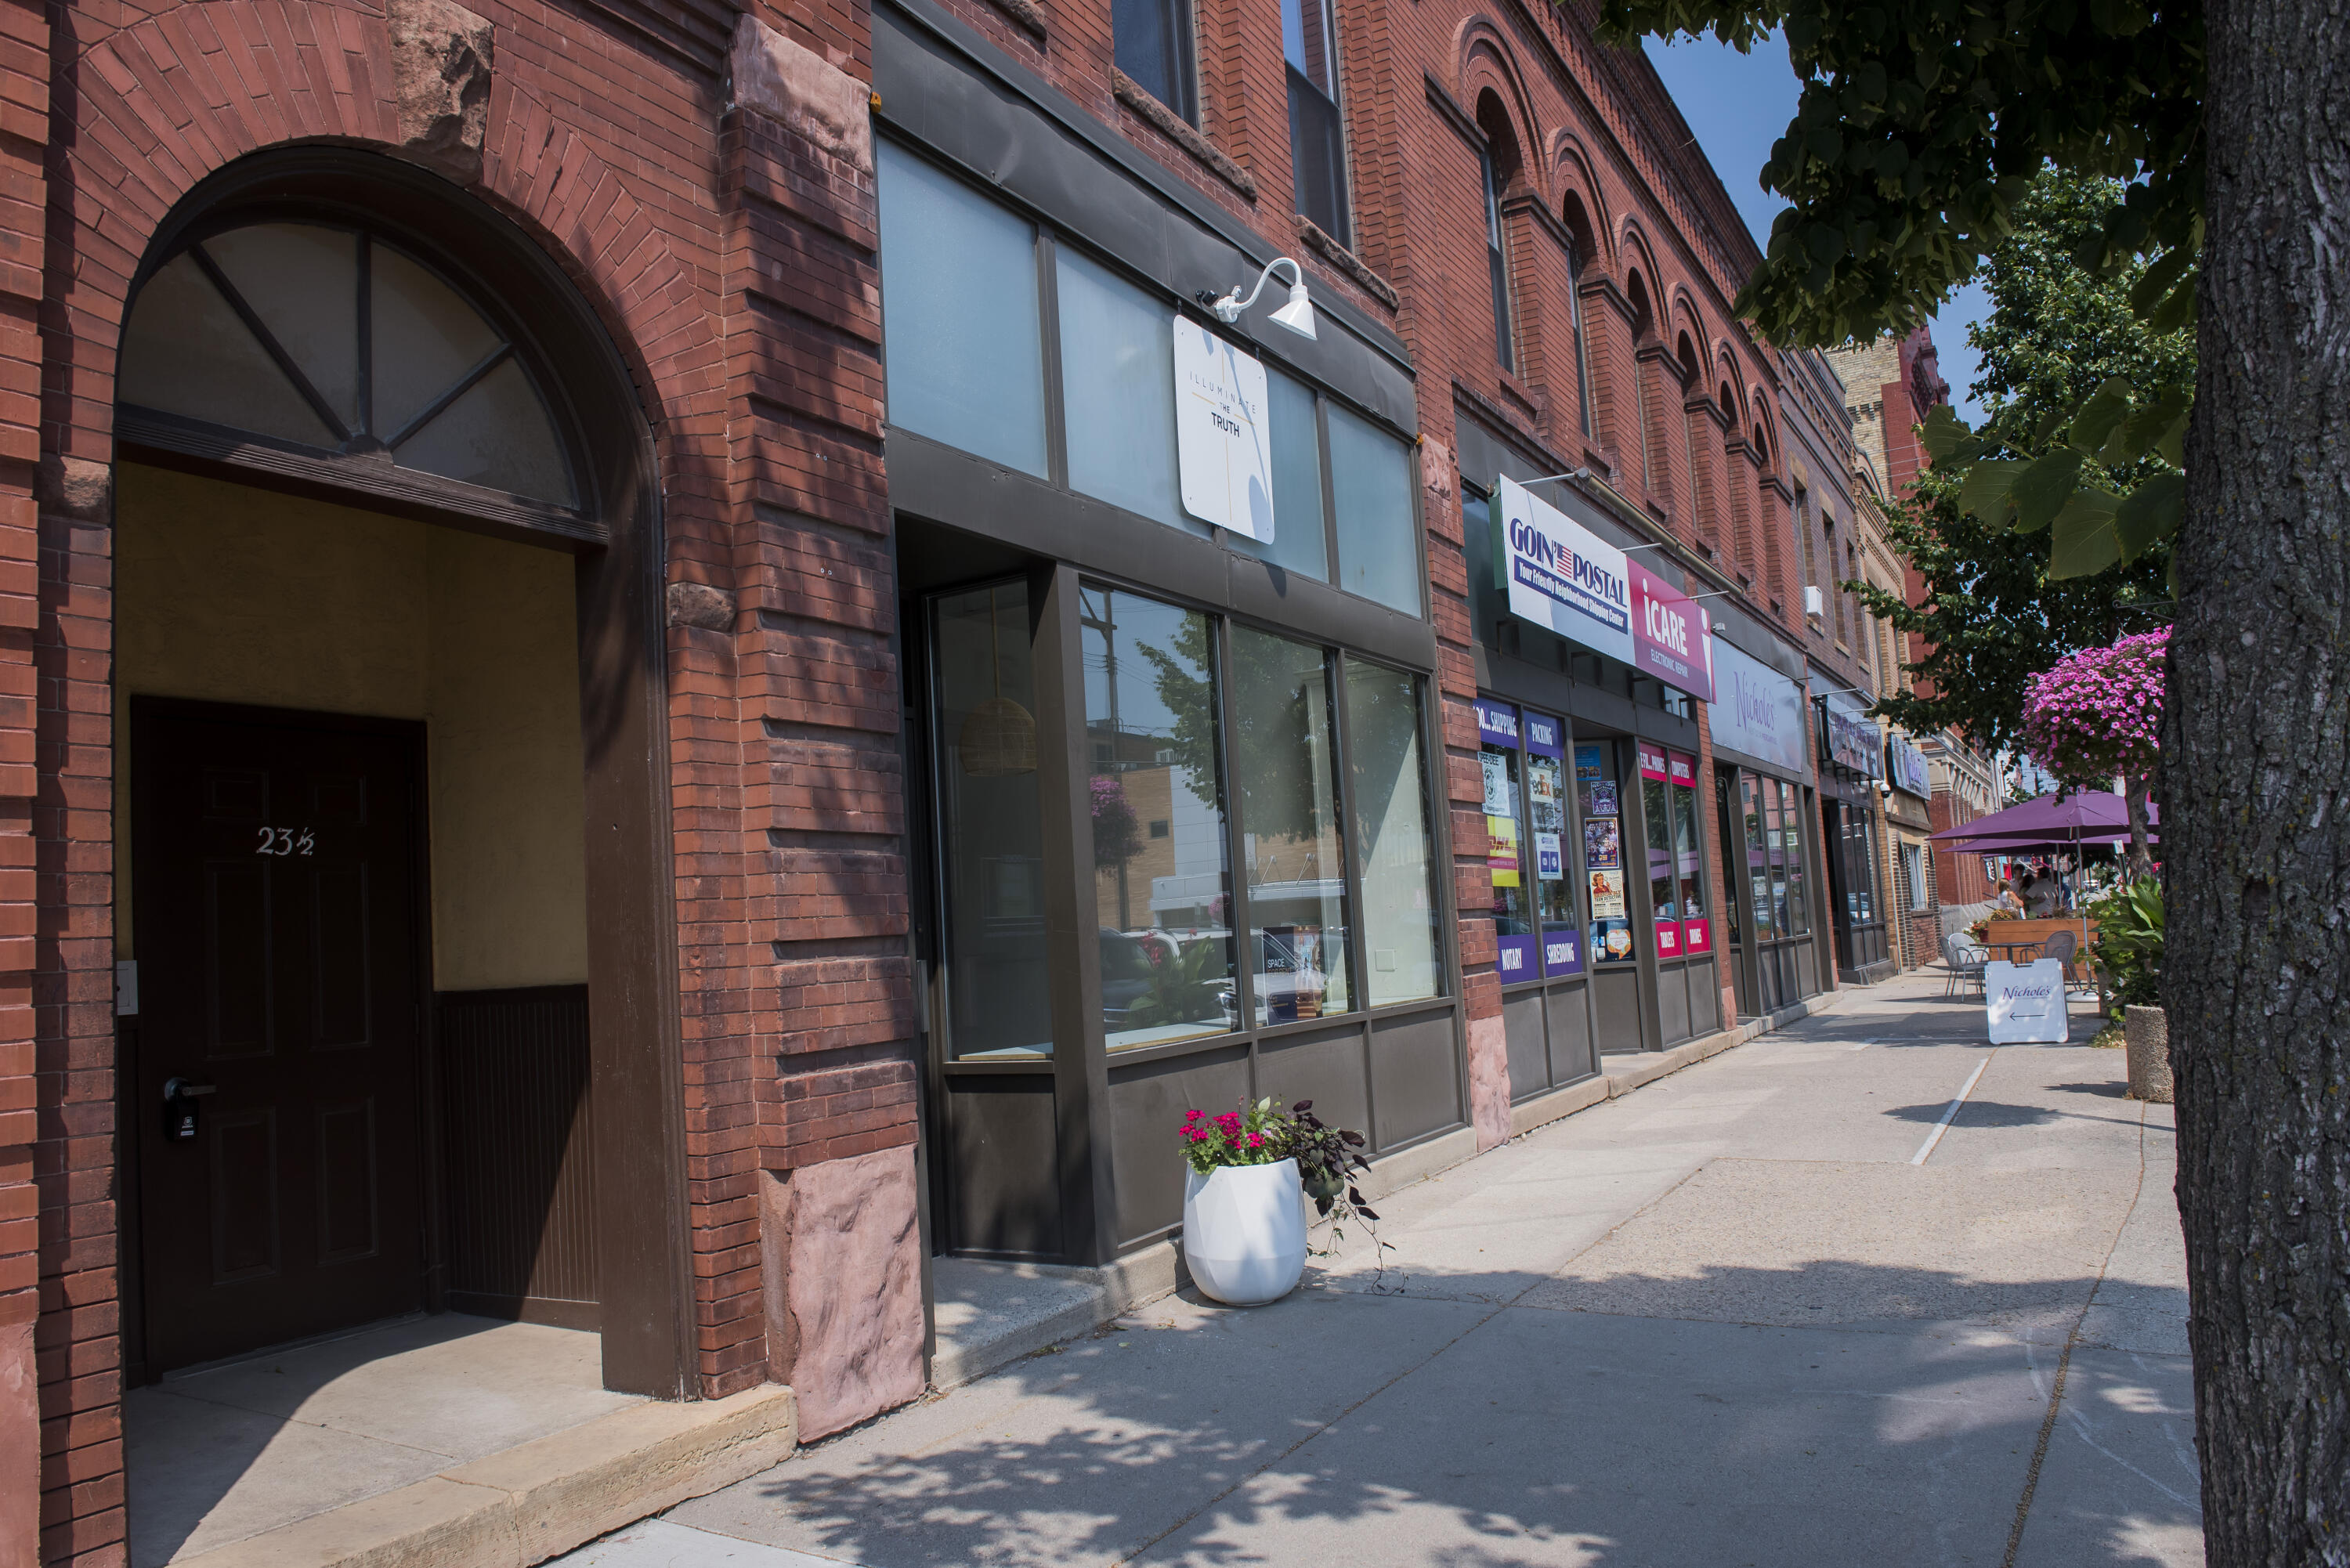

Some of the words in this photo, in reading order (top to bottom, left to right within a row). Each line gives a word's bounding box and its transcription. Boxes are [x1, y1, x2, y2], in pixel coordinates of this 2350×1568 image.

[1190, 370, 1256, 414] ILLUMINATE
[1220, 402, 1231, 414] THE
[1211, 411, 1240, 438] TRUTH
[1509, 518, 1557, 569] GOIN'
[1572, 552, 1628, 608] POSTAL
[1519, 562, 1532, 582] Your
[1532, 568, 1555, 594] Friendly
[1555, 578, 1589, 611] Neighborhood
[1589, 596, 1609, 623] Shipping
[1608, 609, 1624, 627] Center
[1650, 649, 1676, 671] ELECTRONIC
[1675, 662, 1689, 678] REPAIR
[1734, 670, 1774, 733] Nichole's
[1490, 710, 1517, 737] SHIPPING
[1531, 722, 1553, 746] PACKING
[1671, 760, 1690, 779] COMPUTERS
[1267, 958, 1285, 969] SPACE
[1501, 948, 1523, 971] NOTARY
[1546, 942, 1574, 965] SHREDDING
[2001, 985, 2051, 1000] Nichole's
